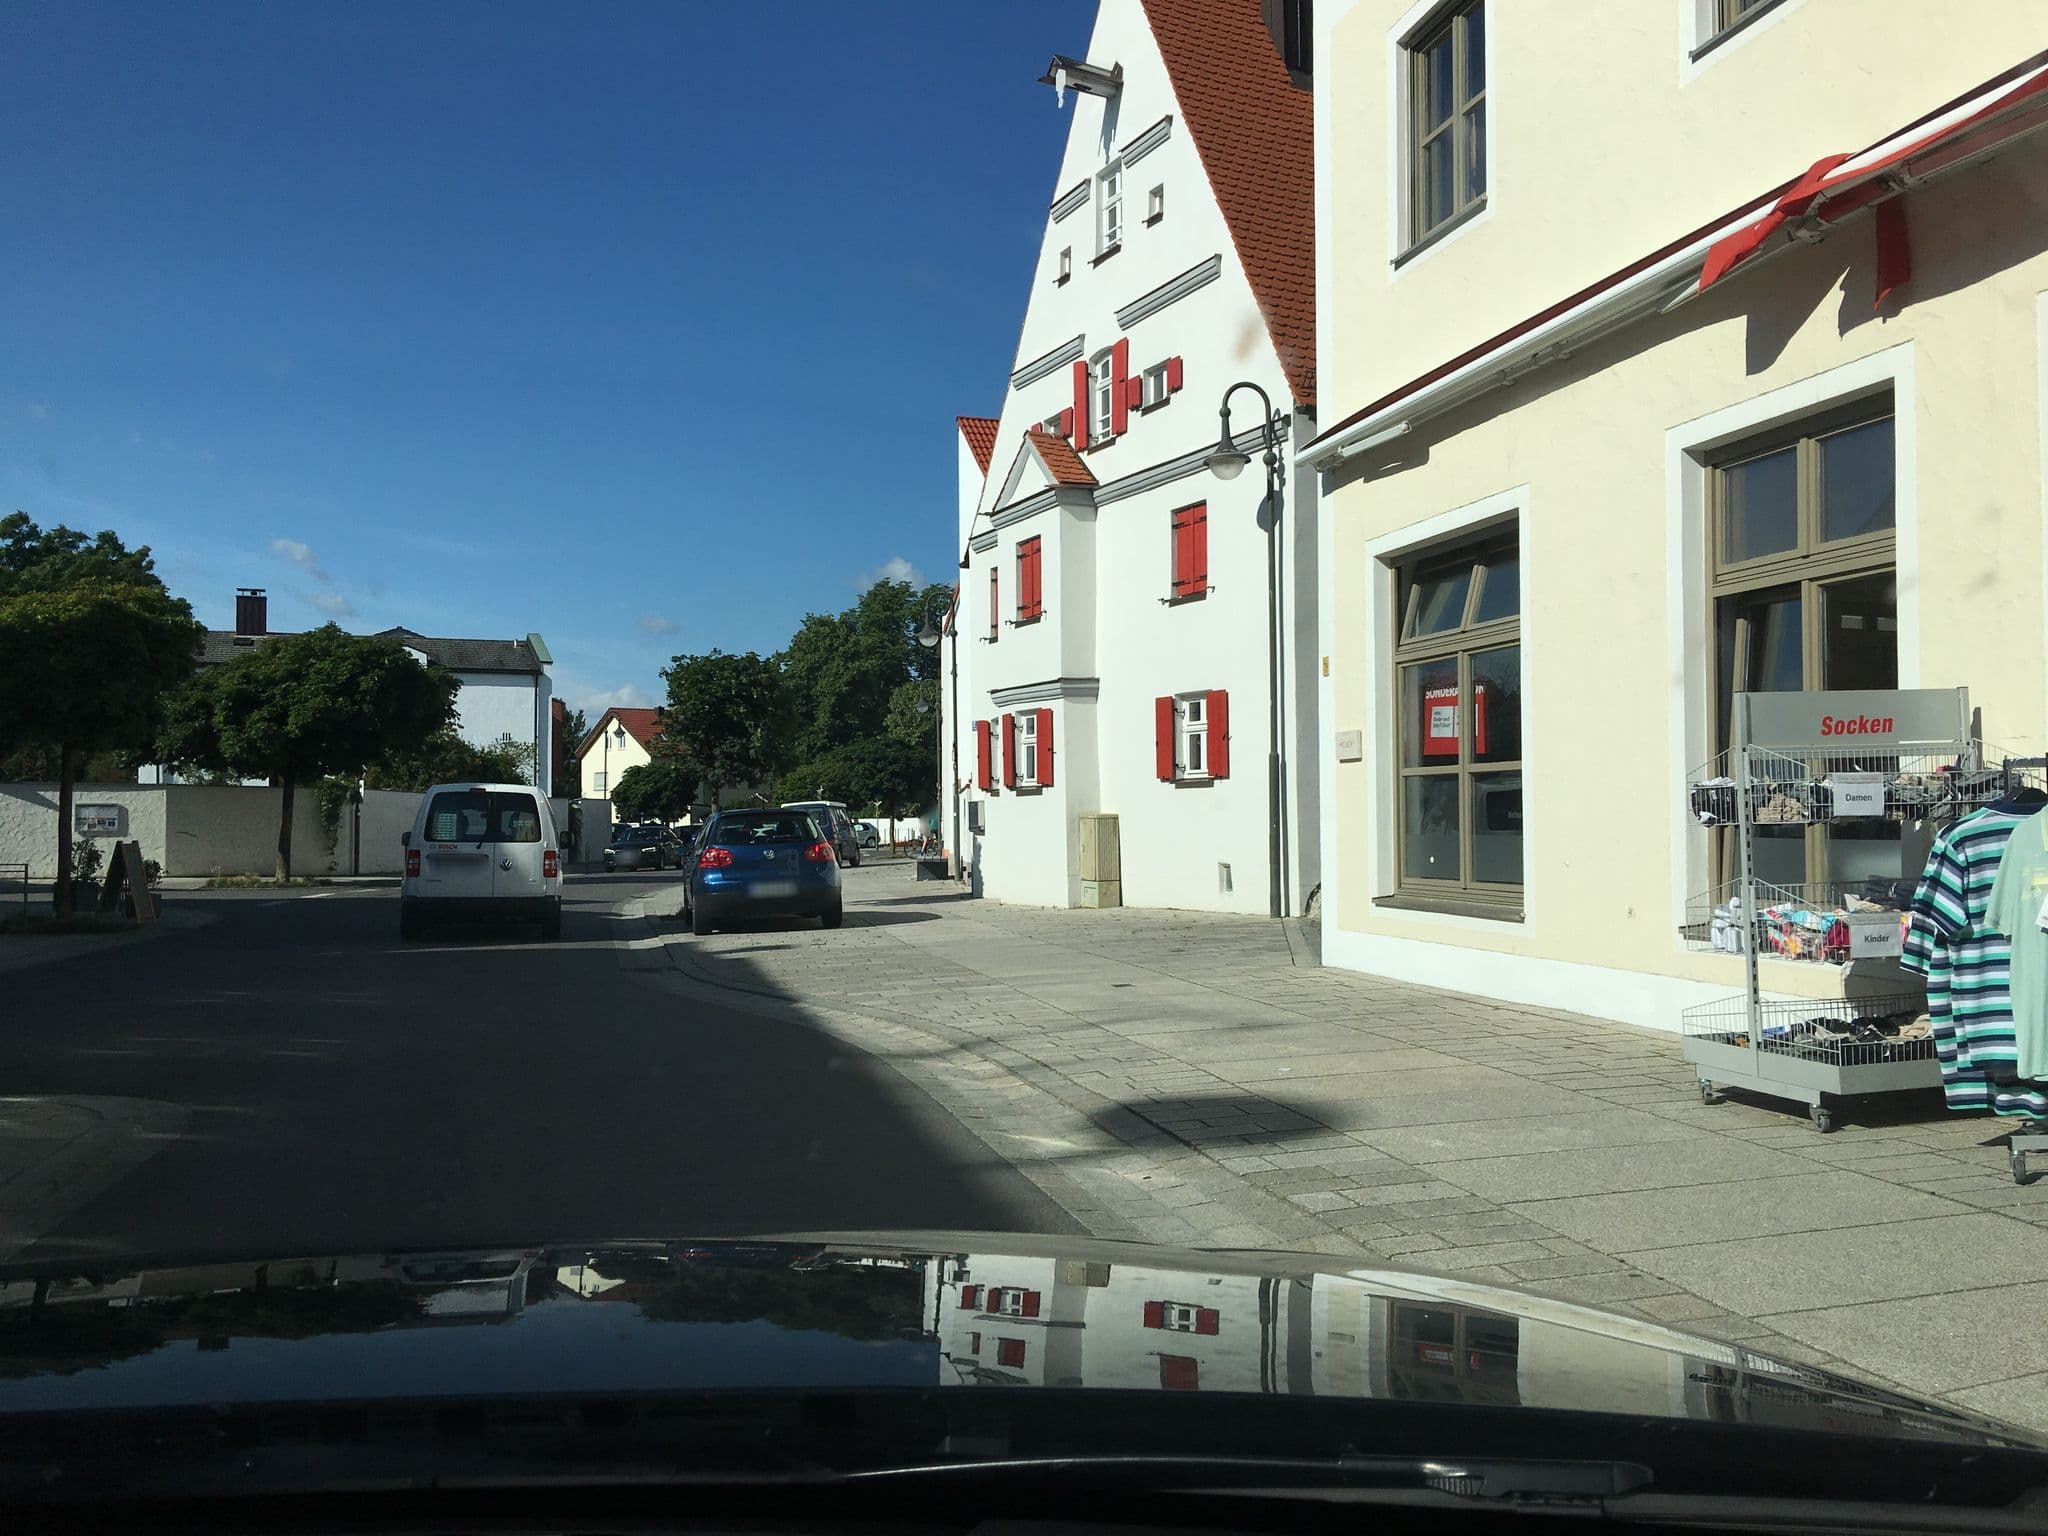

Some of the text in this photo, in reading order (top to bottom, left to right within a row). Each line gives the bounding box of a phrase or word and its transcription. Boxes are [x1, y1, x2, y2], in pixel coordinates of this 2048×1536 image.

[1820, 714, 1894, 736] Socken
[1845, 793, 1873, 802] Damen
[1864, 934, 1890, 943] Kinder
